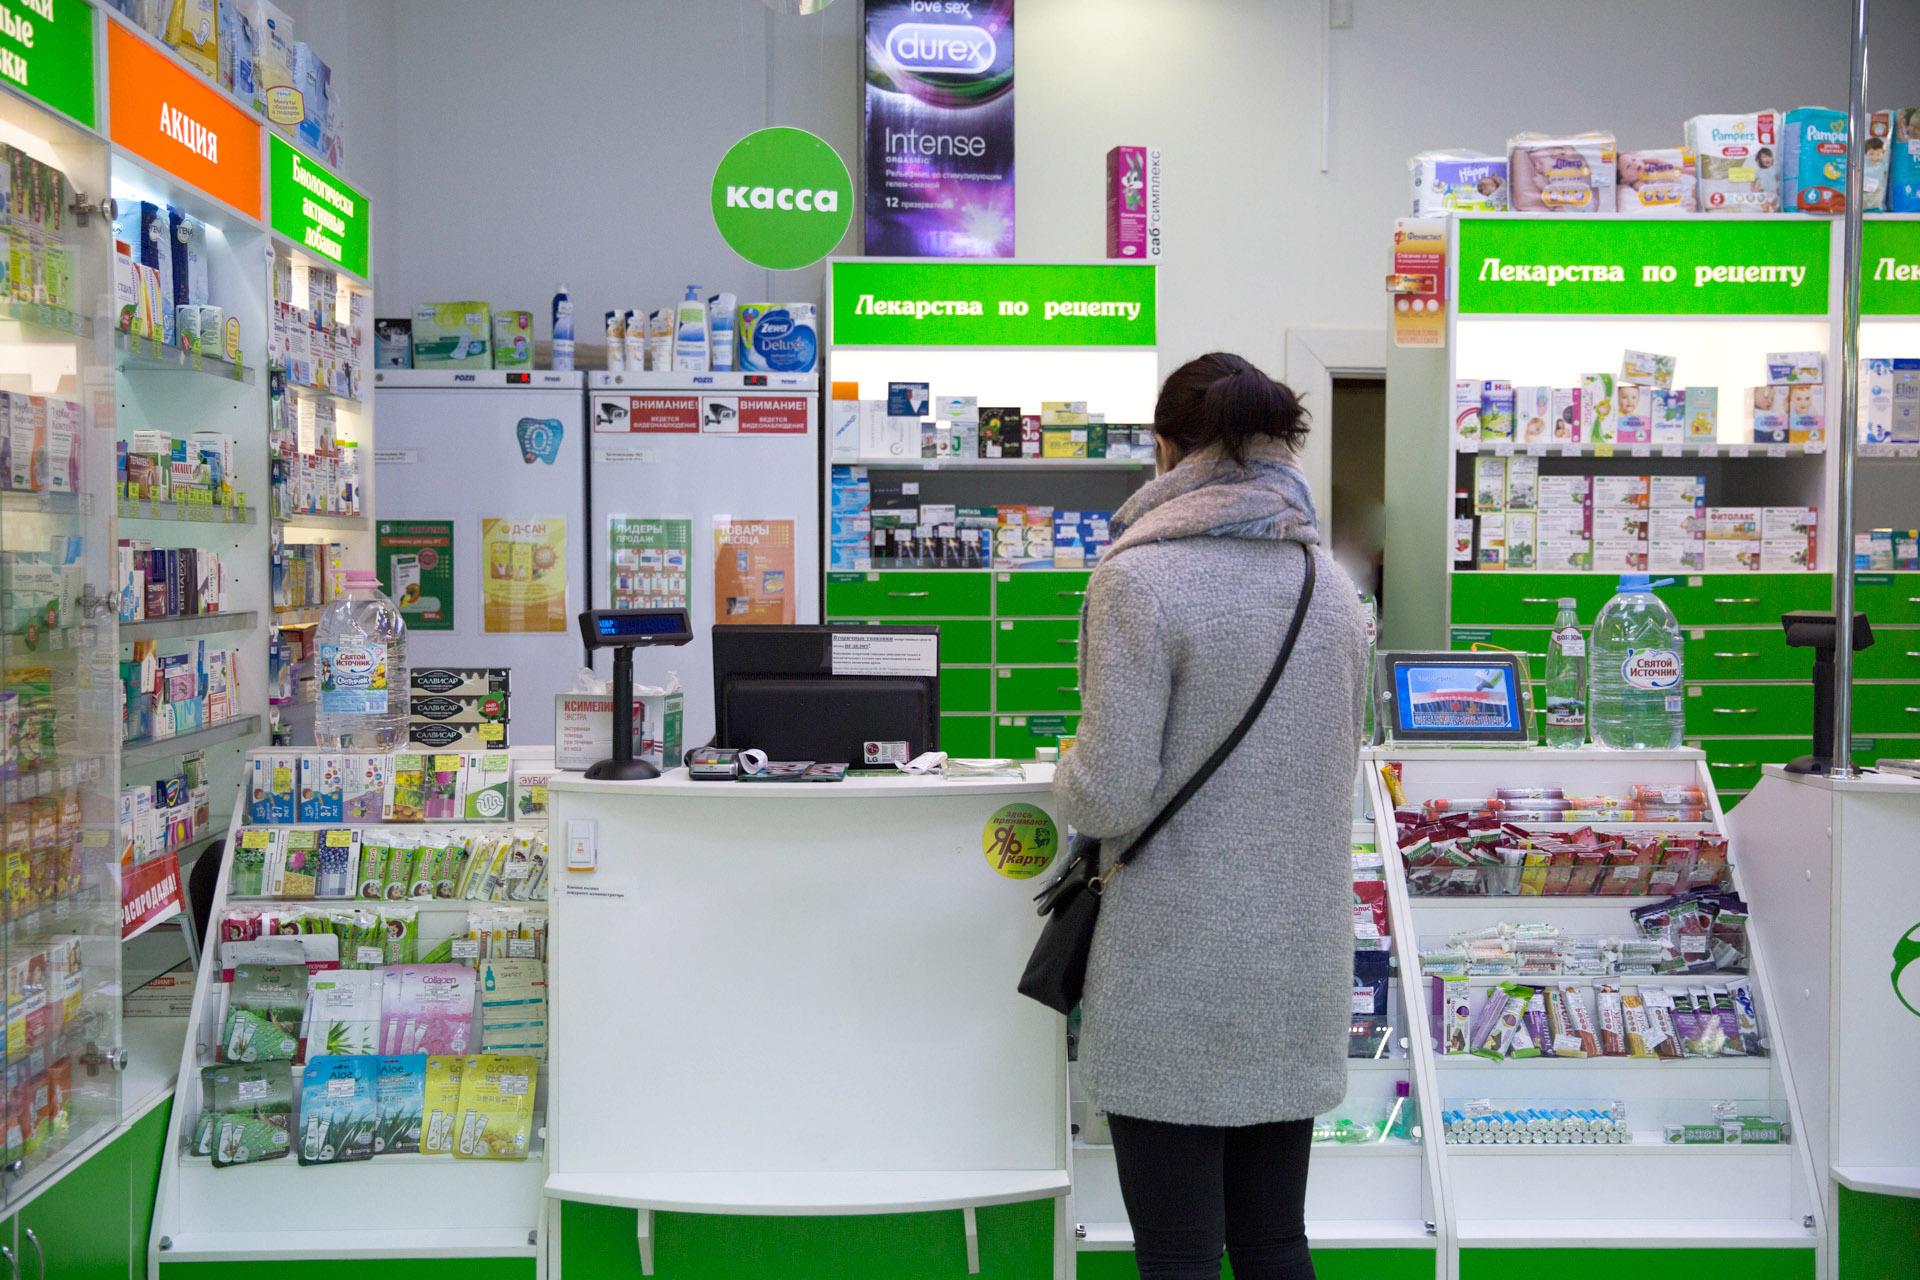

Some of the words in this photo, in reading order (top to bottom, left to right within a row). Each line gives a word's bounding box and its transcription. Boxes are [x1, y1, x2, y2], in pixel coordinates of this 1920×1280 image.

[911, 0, 941, 13] love
[945, 3, 972, 19] sex
[897, 31, 984, 61] durex
[0, 47, 28, 86] ки
[160, 102, 217, 164] АКЦИЯ
[1712, 128, 1756, 143] Pampers
[1807, 125, 1847, 145] Pampe
[885, 127, 986, 157] Intense
[293, 154, 354, 218] Биологически
[1151, 151, 1161, 222] симплекс
[727, 186, 838, 212] касса
[886, 197, 899, 208] 12
[1713, 194, 1721, 204] 5
[302, 197, 346, 238] активные
[304, 224, 342, 262] добавки
[1149, 228, 1161, 255] саб
[1479, 258, 1625, 286] Лекарства
[1642, 266, 1678, 282] по
[1694, 266, 1807, 287] рецепту
[855, 294, 984, 319] Лекарства
[998, 301, 1029, 316] по
[1044, 301, 1141, 320] рецепту
[761, 323, 788, 334] Zewa
[632, 400, 698, 410] ВНИМАНИЕ!
[740, 400, 806, 411] ВНИМАНИЕ!
[1711, 513, 1755, 521] ФИТОЛАКС
[512, 524, 547, 535] Д-САН
[616, 524, 663, 534] ЛИДЕРЫ
[719, 525, 769, 535] ТОВАРЫ
[616, 535, 654, 544] ПРОДАЖ
[719, 536, 760, 545] МЕСЯЦА
[1637, 658, 1673, 668] Святой
[1630, 667, 1678, 677] Источник
[520, 776, 548, 785] ЭУБИ
[1006, 855, 1049, 868] карту
[121, 873, 177, 928] РАСПРОДАЖА!
[422, 976, 457, 984] Collagen
[330, 1071, 353, 1079] Aloe
[381, 1065, 404, 1073] Aloe
